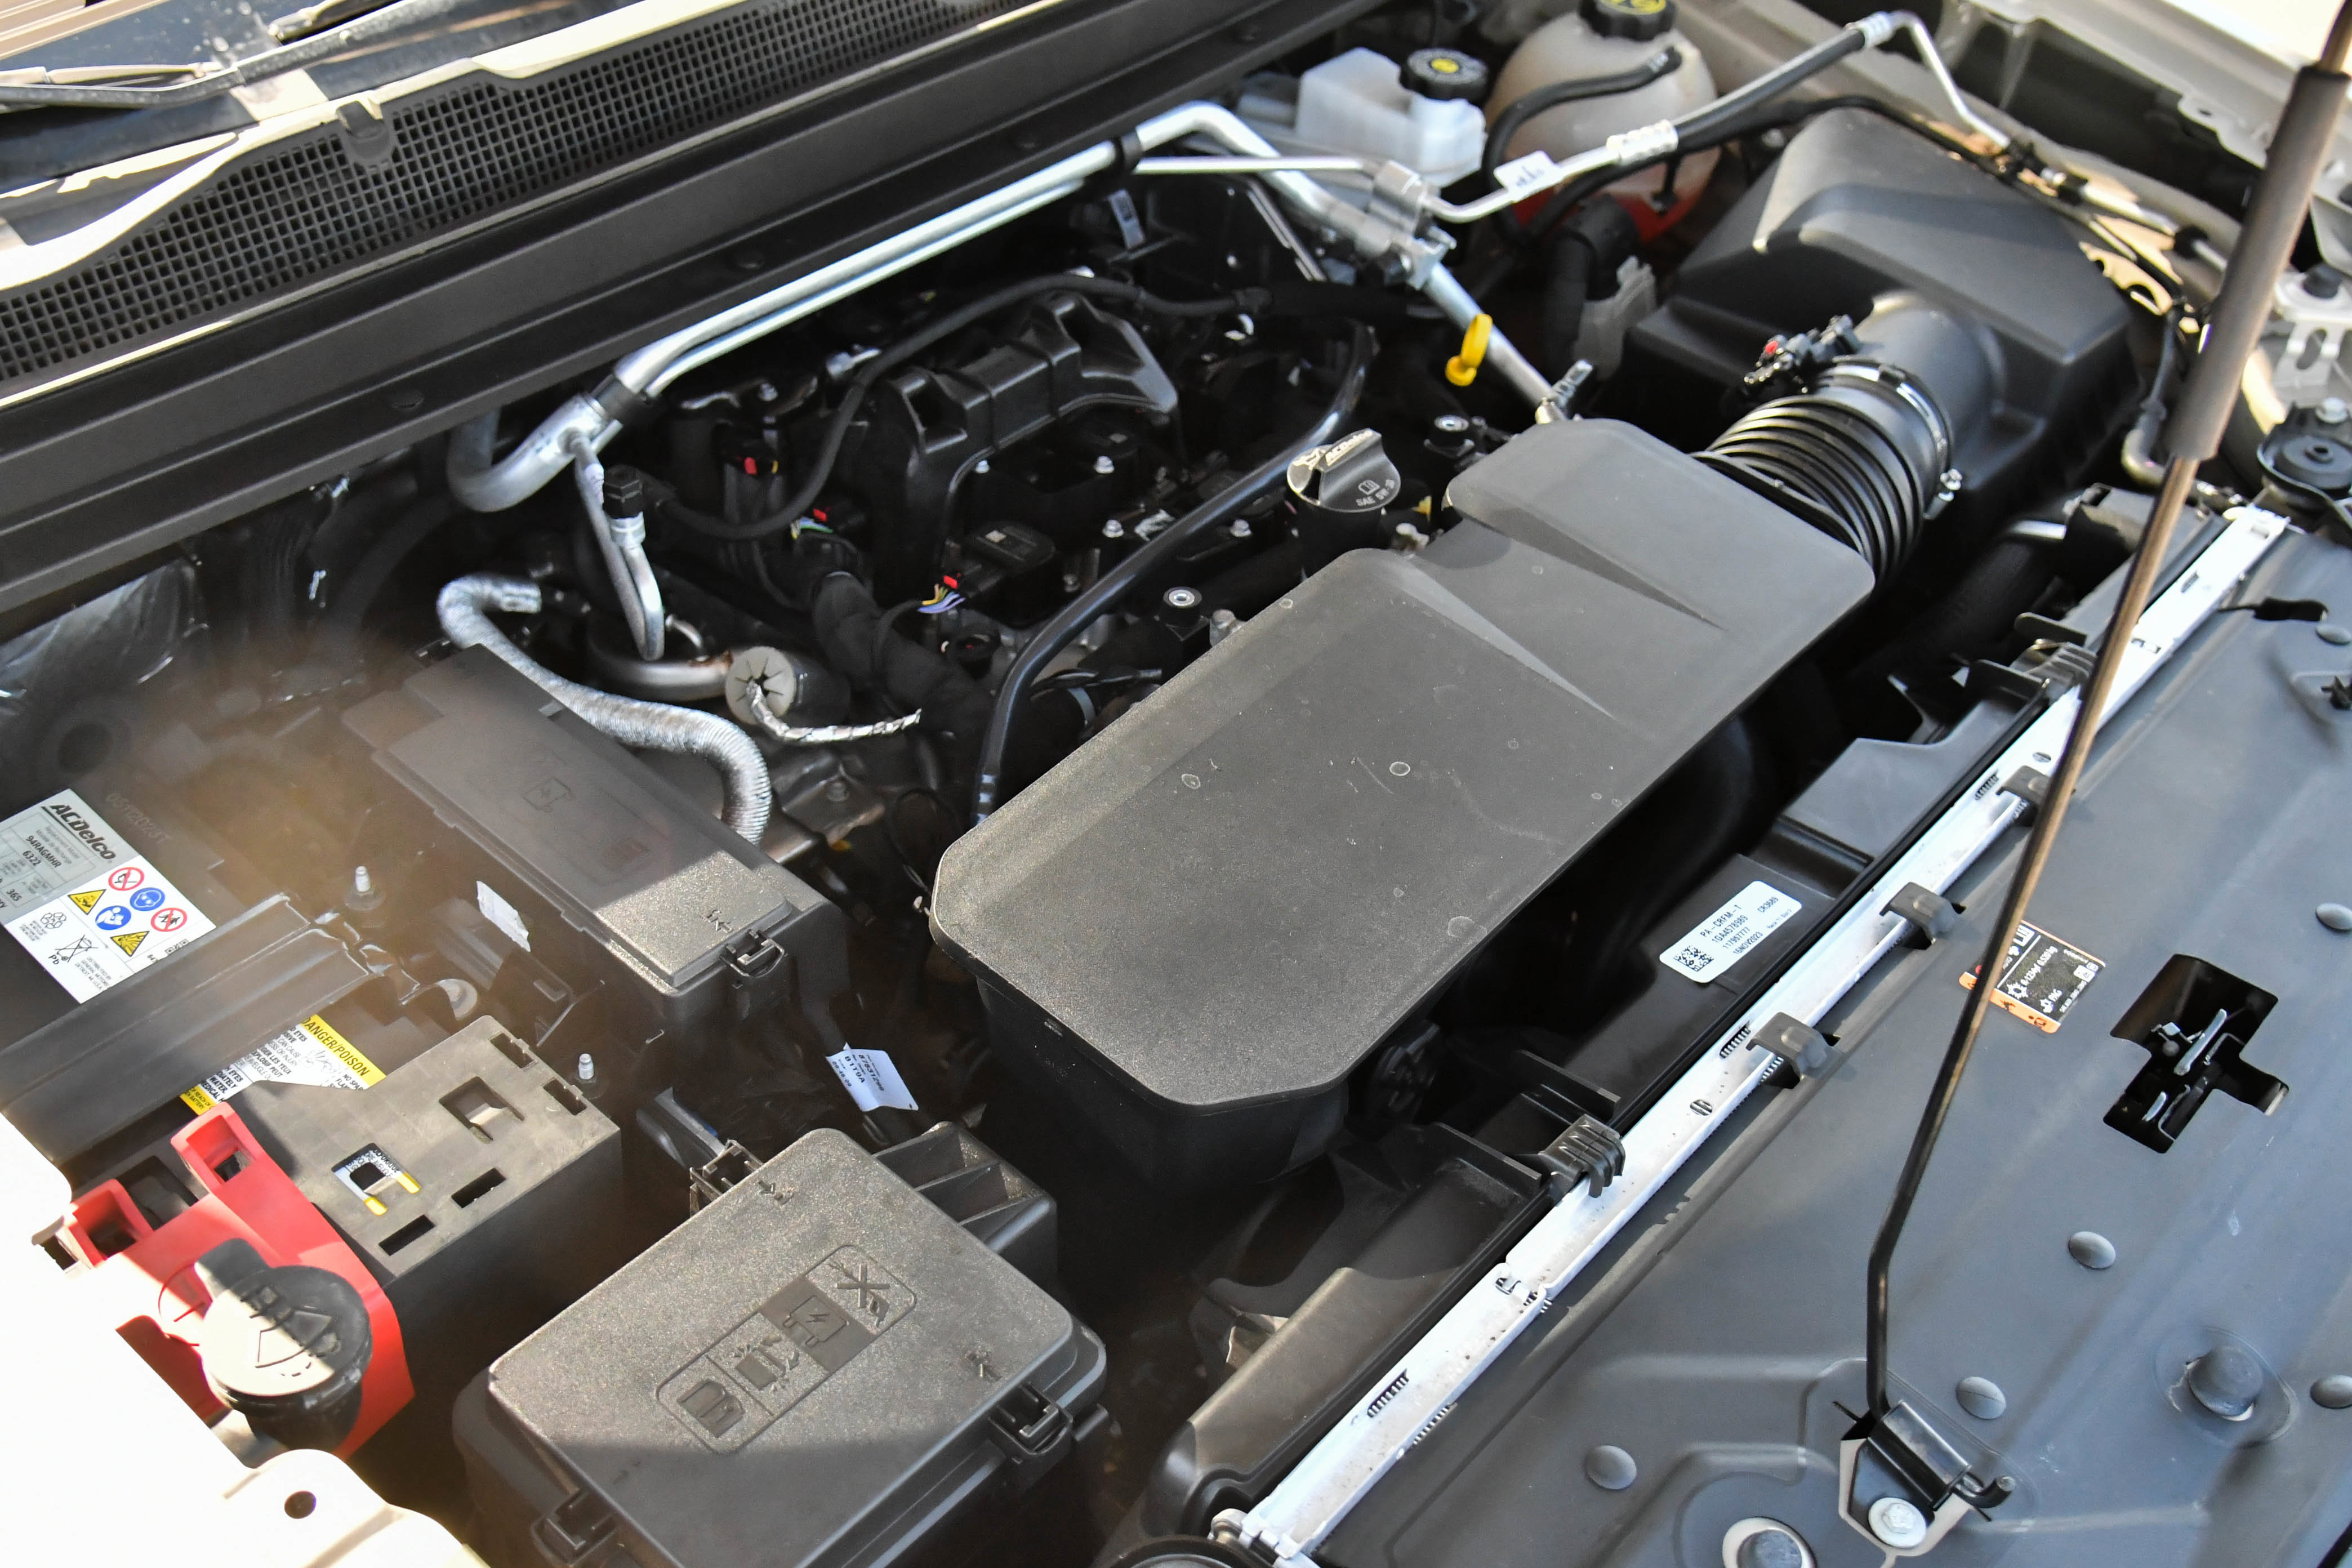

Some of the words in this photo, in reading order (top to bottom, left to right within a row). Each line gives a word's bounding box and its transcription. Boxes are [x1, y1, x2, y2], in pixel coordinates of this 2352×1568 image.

[1356, 496, 1375, 506] SAE
[50, 804, 116, 859] ACDelco
[26, 835, 62, 868] 94RAGMHR
[23, 850, 41, 867] 6322
[6, 889, 22, 901] 365
[48, 955, 59, 965] Pb
[294, 1031, 308, 1042] EYES
[269, 1055, 280, 1064] LES
[278, 1063, 292, 1075] YEUX
[229, 1070, 244, 1082] EYES
[269, 1066, 283, 1077] PEUT
